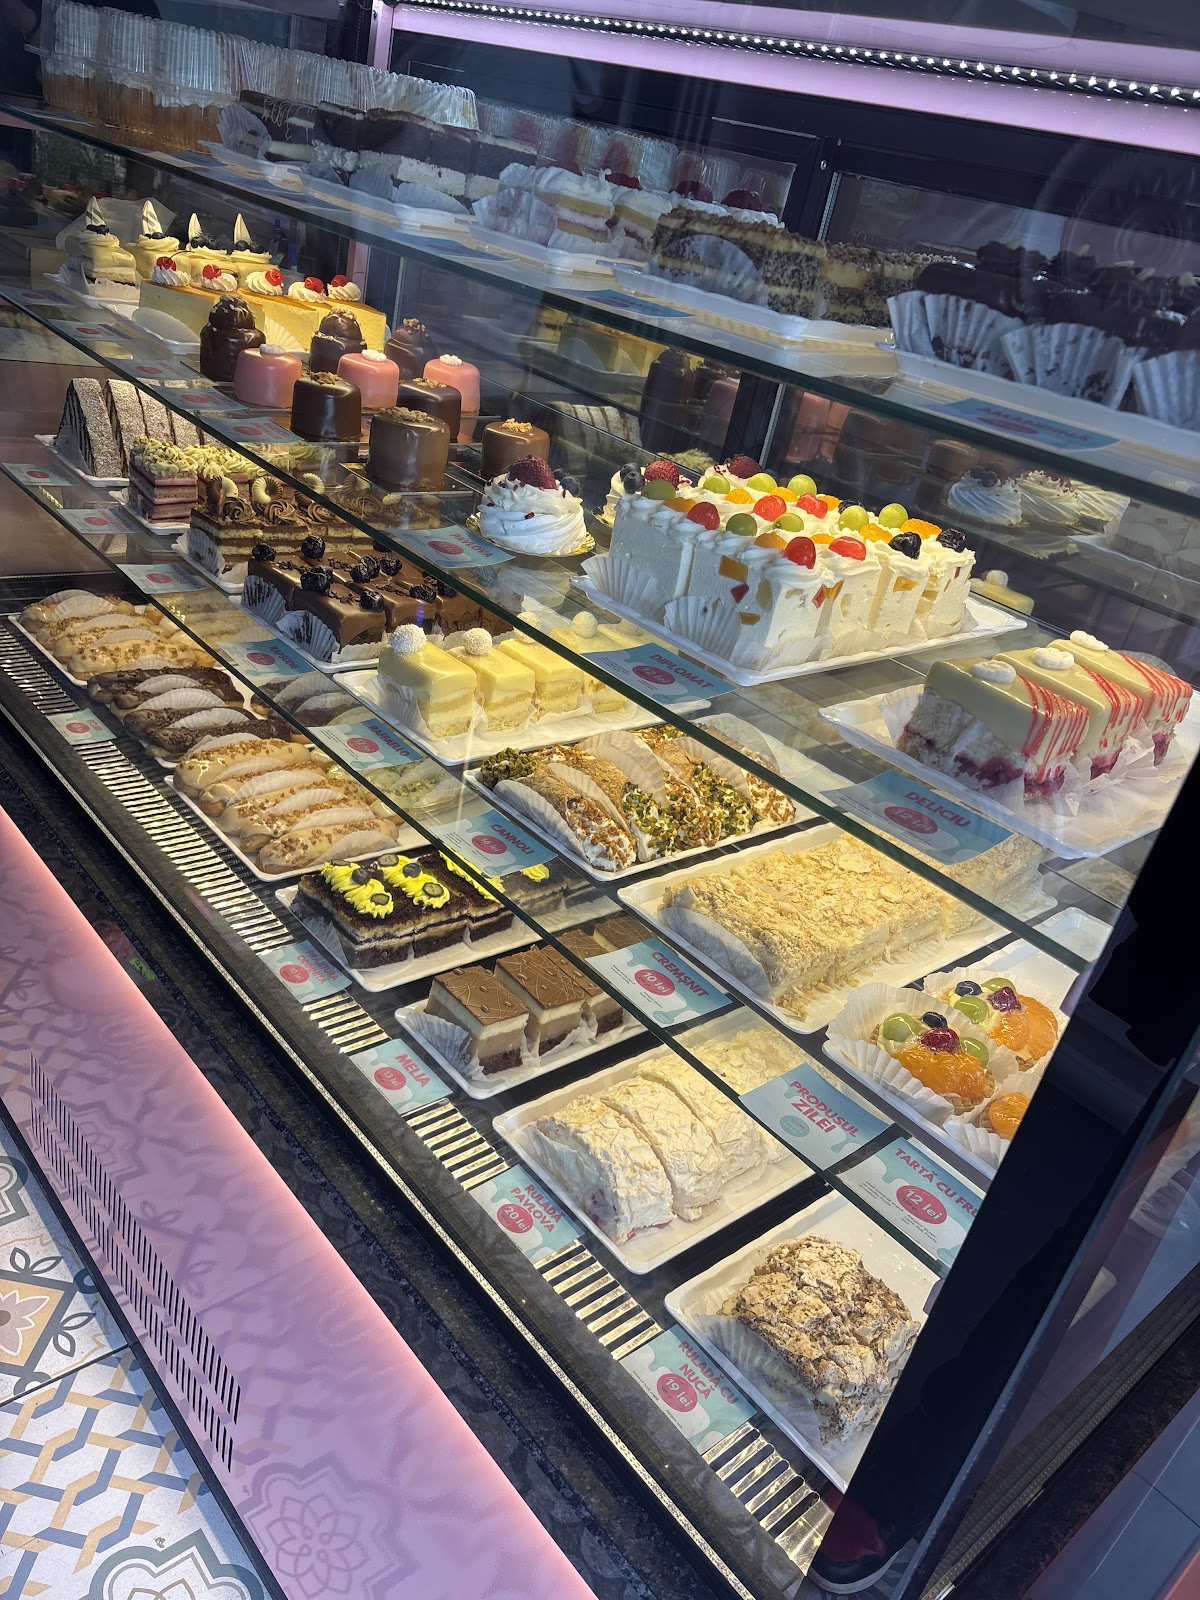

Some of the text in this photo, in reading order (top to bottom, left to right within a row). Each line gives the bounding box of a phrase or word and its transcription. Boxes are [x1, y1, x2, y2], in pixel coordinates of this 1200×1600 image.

[449, 533, 494, 558] PAVLOVA
[640, 667, 672, 684] 12 lei
[649, 654, 714, 688] DIPLOMAT
[368, 725, 410, 756] RAFFAELLO
[892, 809, 933, 832] 12 lei
[904, 791, 972, 828] DELICIU
[488, 844, 502, 852] lei
[491, 824, 535, 855] CANNOLI
[643, 972, 670, 993] 10 lei
[384, 1070, 394, 1079] 13
[390, 1077, 402, 1086] lei
[395, 1053, 431, 1087] MELIA
[790, 1081, 860, 1138] PRODUSUL
[791, 1099, 836, 1133] ZILEI
[895, 1148, 938, 1183] TARTĂ
[936, 1181, 957, 1198] CU
[503, 1206, 519, 1220] 20
[515, 1218, 530, 1231] lei
[510, 1187, 555, 1233] PAVLOVA
[524, 1184, 565, 1223] RULADĂ
[904, 1189, 924, 1205] 12
[922, 1203, 943, 1220] lei
[678, 1340, 740, 1405] RULADĂ CU
[679, 1363, 716, 1400] NUCĂ
[665, 1378, 680, 1391] 19
[676, 1391, 694, 1408] lei
